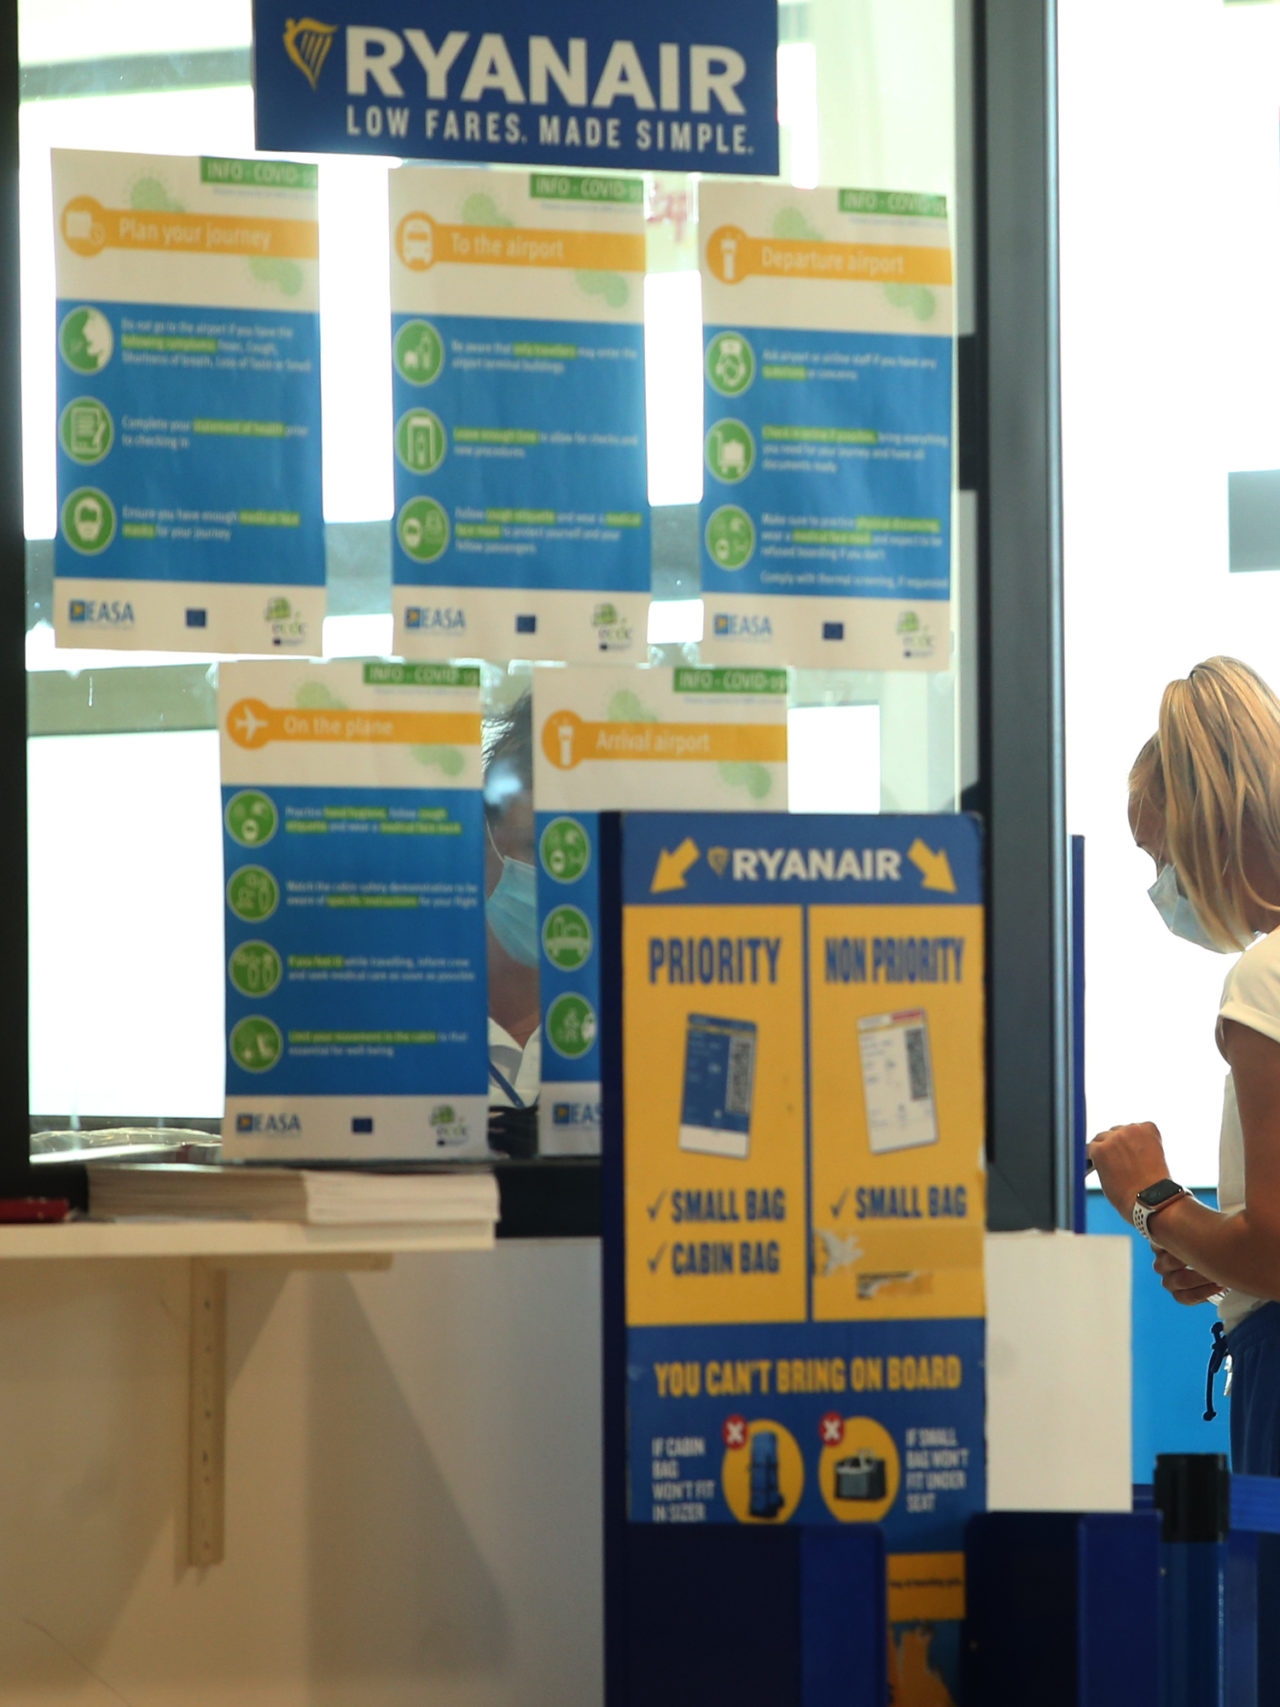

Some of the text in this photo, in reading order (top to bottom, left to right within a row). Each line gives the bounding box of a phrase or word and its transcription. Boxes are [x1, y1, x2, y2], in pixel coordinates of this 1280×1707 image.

[346, 26, 747, 116] RYANAIR
[347, 104, 756, 155] LOW FARES. MADE SIMPLE.
[208, 161, 243, 178] INFO
[536, 176, 570, 194] INFO
[845, 193, 877, 209] INFO
[118, 218, 272, 252] Plan your journey
[451, 233, 564, 261] To the airport
[761, 246, 905, 276] Departure airport
[86, 601, 135, 623] EASA
[421, 609, 466, 629] EASA
[728, 614, 773, 636] EASA
[369, 666, 403, 682] INFO
[680, 671, 713, 689] INFO
[283, 716, 394, 740] On the plane
[596, 730, 711, 758] Arrival airport
[733, 848, 902, 881] RYANAIR
[648, 936, 781, 984] PRIORITY
[825, 936, 965, 984] NON PRIORITY
[253, 1112, 302, 1131] EASA
[571, 1107, 603, 1127] EAS
[671, 1188, 786, 1223] SMALL BAG
[855, 1185, 967, 1219] SMALL BAG
[671, 1241, 781, 1276] CABIN BAG
[654, 1355, 963, 1398] YOU CAN'T BRING ON BOARD
[652, 1437, 705, 1457] IF CABIN
[906, 1427, 958, 1447] IF SMALL
[906, 1447, 969, 1468] BAG WON'T
[652, 1460, 679, 1479] BAG
[906, 1469, 966, 1489] FIT UNDER
[652, 1480, 716, 1500] WON'T FIT
[652, 1502, 706, 1522] IN SIZER
[906, 1493, 936, 1512] SEAT
